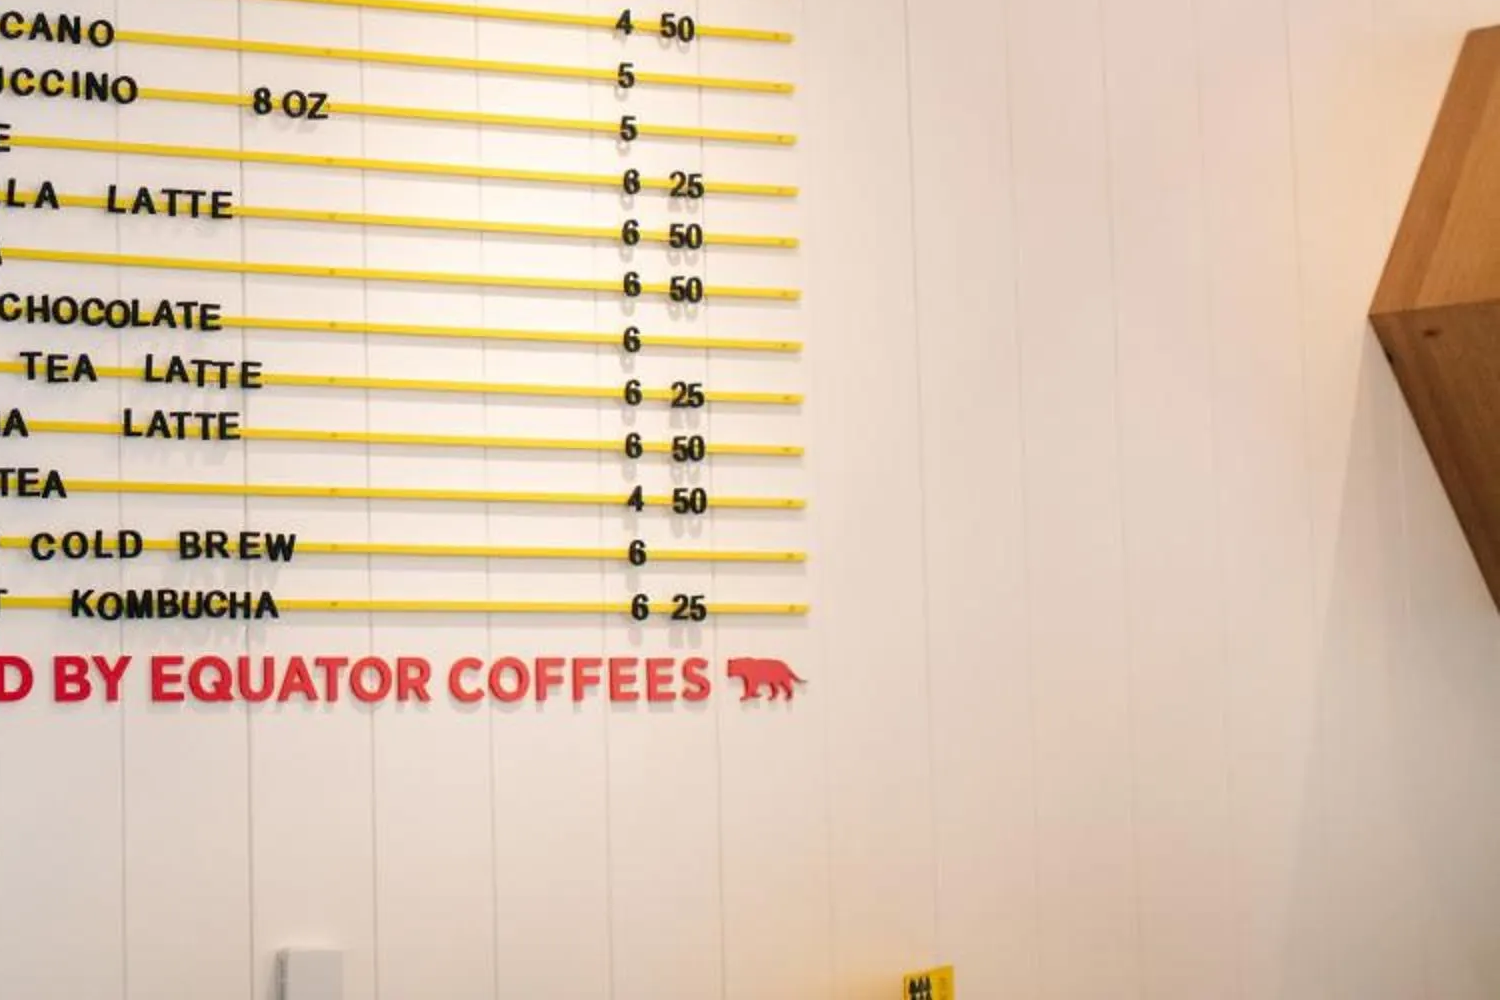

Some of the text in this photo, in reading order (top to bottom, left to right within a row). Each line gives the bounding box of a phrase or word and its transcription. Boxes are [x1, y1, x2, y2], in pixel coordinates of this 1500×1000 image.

[615, 9, 634, 35] 4
[660, 13, 695, 43] 50
[618, 63, 635, 89] 5
[252, 87, 273, 116] 8
[282, 90, 329, 120] OZ
[620, 115, 638, 142] 5
[623, 169, 641, 195] 6
[669, 171, 705, 199] 25
[106, 184, 233, 220] LATTE
[622, 219, 640, 246] 6
[669, 223, 703, 250] 50
[623, 271, 641, 297] 6
[669, 276, 703, 304] 50
[623, 326, 641, 353] 6
[19, 351, 98, 384] TEA
[143, 353, 263, 390] LATTE
[624, 379, 642, 406] 6
[671, 381, 705, 409] 25
[123, 408, 241, 441] LATTE
[625, 433, 643, 459] 6
[672, 435, 705, 463] 50
[626, 485, 645, 512] 4
[672, 487, 707, 515] 50
[29, 529, 143, 562] COLD
[178, 530, 296, 563] BREW
[628, 539, 647, 567] 6
[69, 589, 280, 622] KOMBUCHA
[631, 593, 650, 621] 6
[670, 594, 707, 622] 25
[52, 654, 132, 705] BY
[150, 654, 432, 704] EQUATOR
[447, 656, 713, 703] COFFEES
